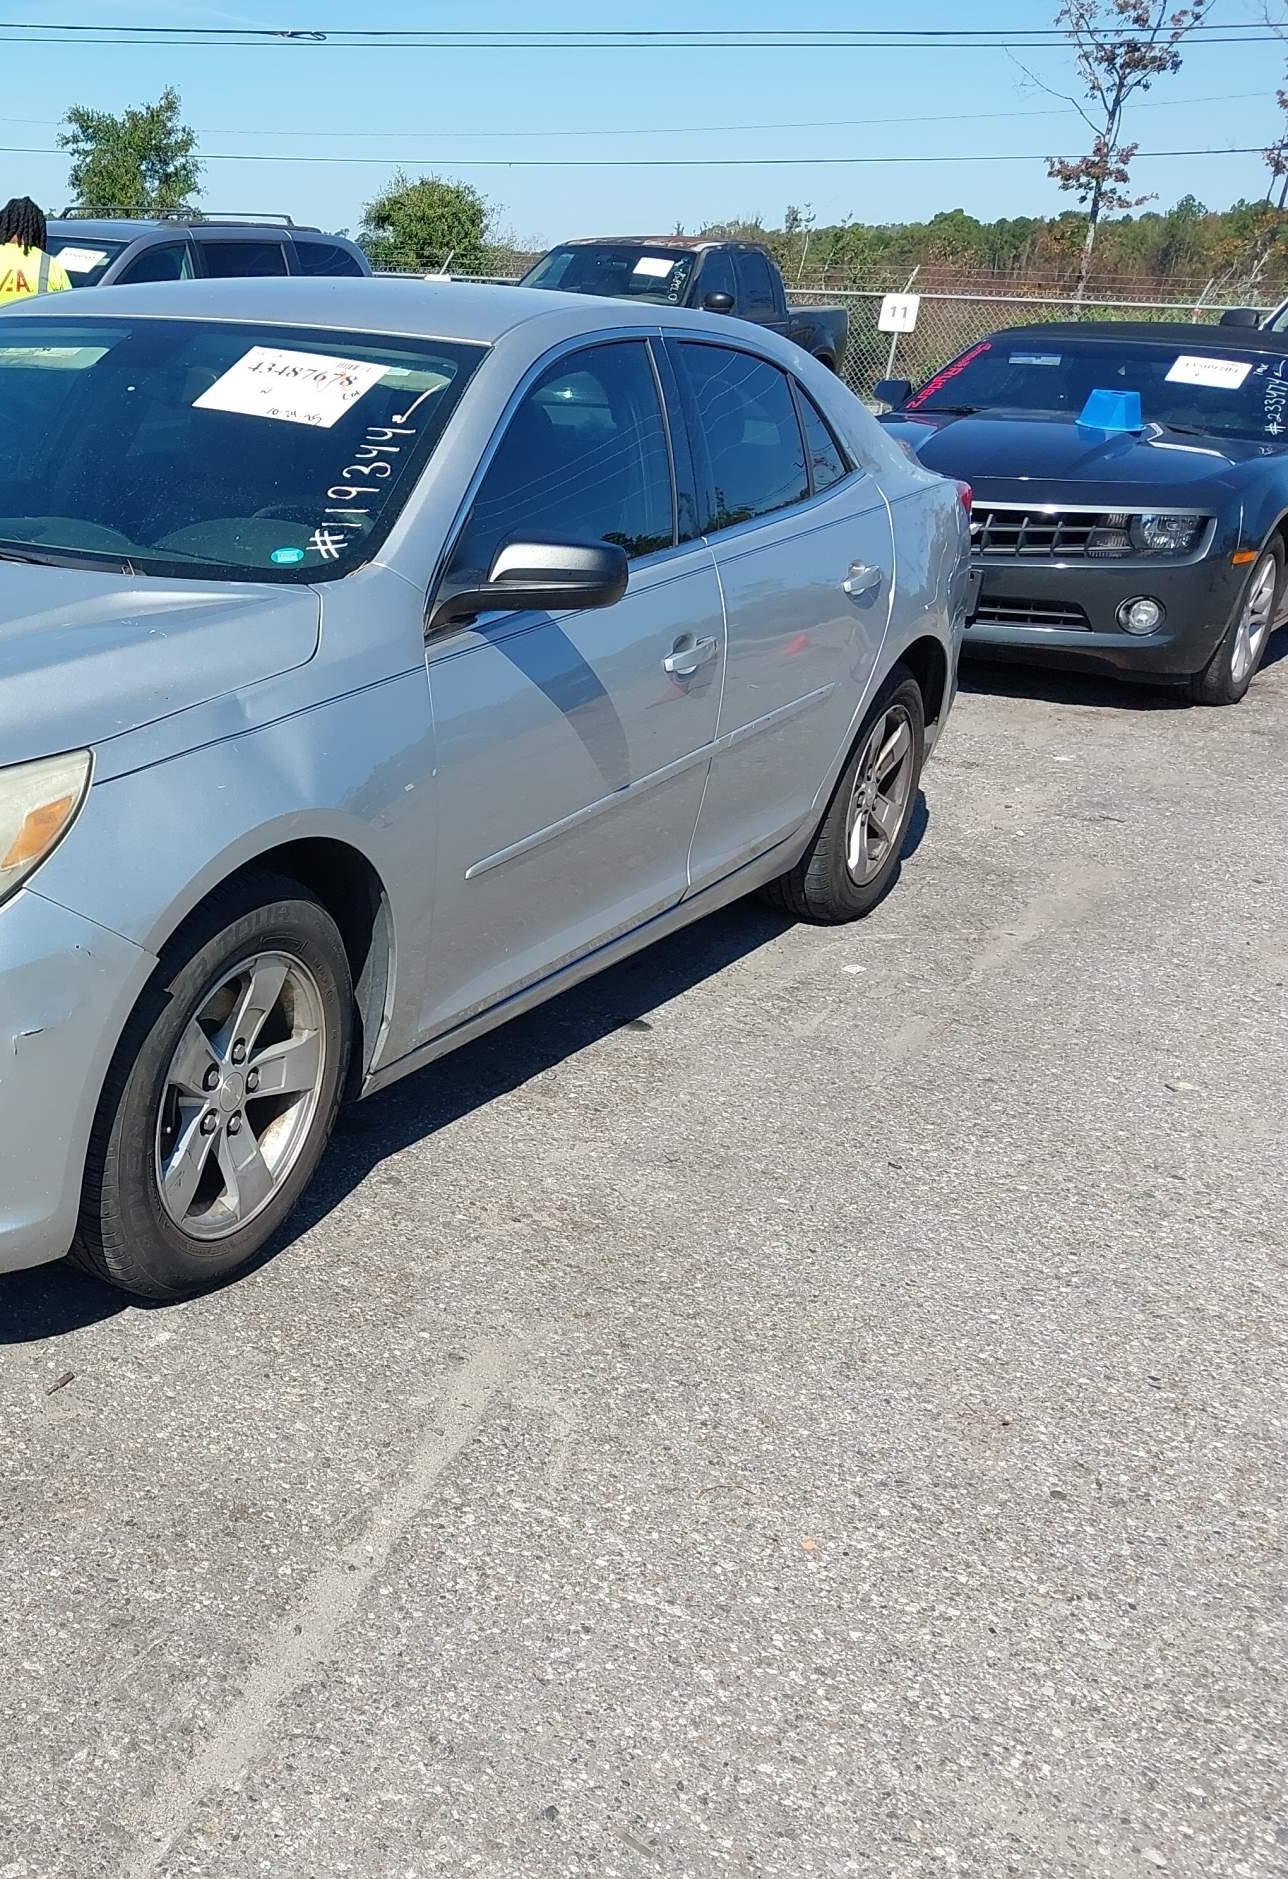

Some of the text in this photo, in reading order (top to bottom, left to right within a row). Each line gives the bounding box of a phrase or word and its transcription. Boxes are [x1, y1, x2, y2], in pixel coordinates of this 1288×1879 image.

[889, 305, 909, 318] 11
[248, 361, 358, 389] 43487678
[305, 427, 416, 558] #119344
